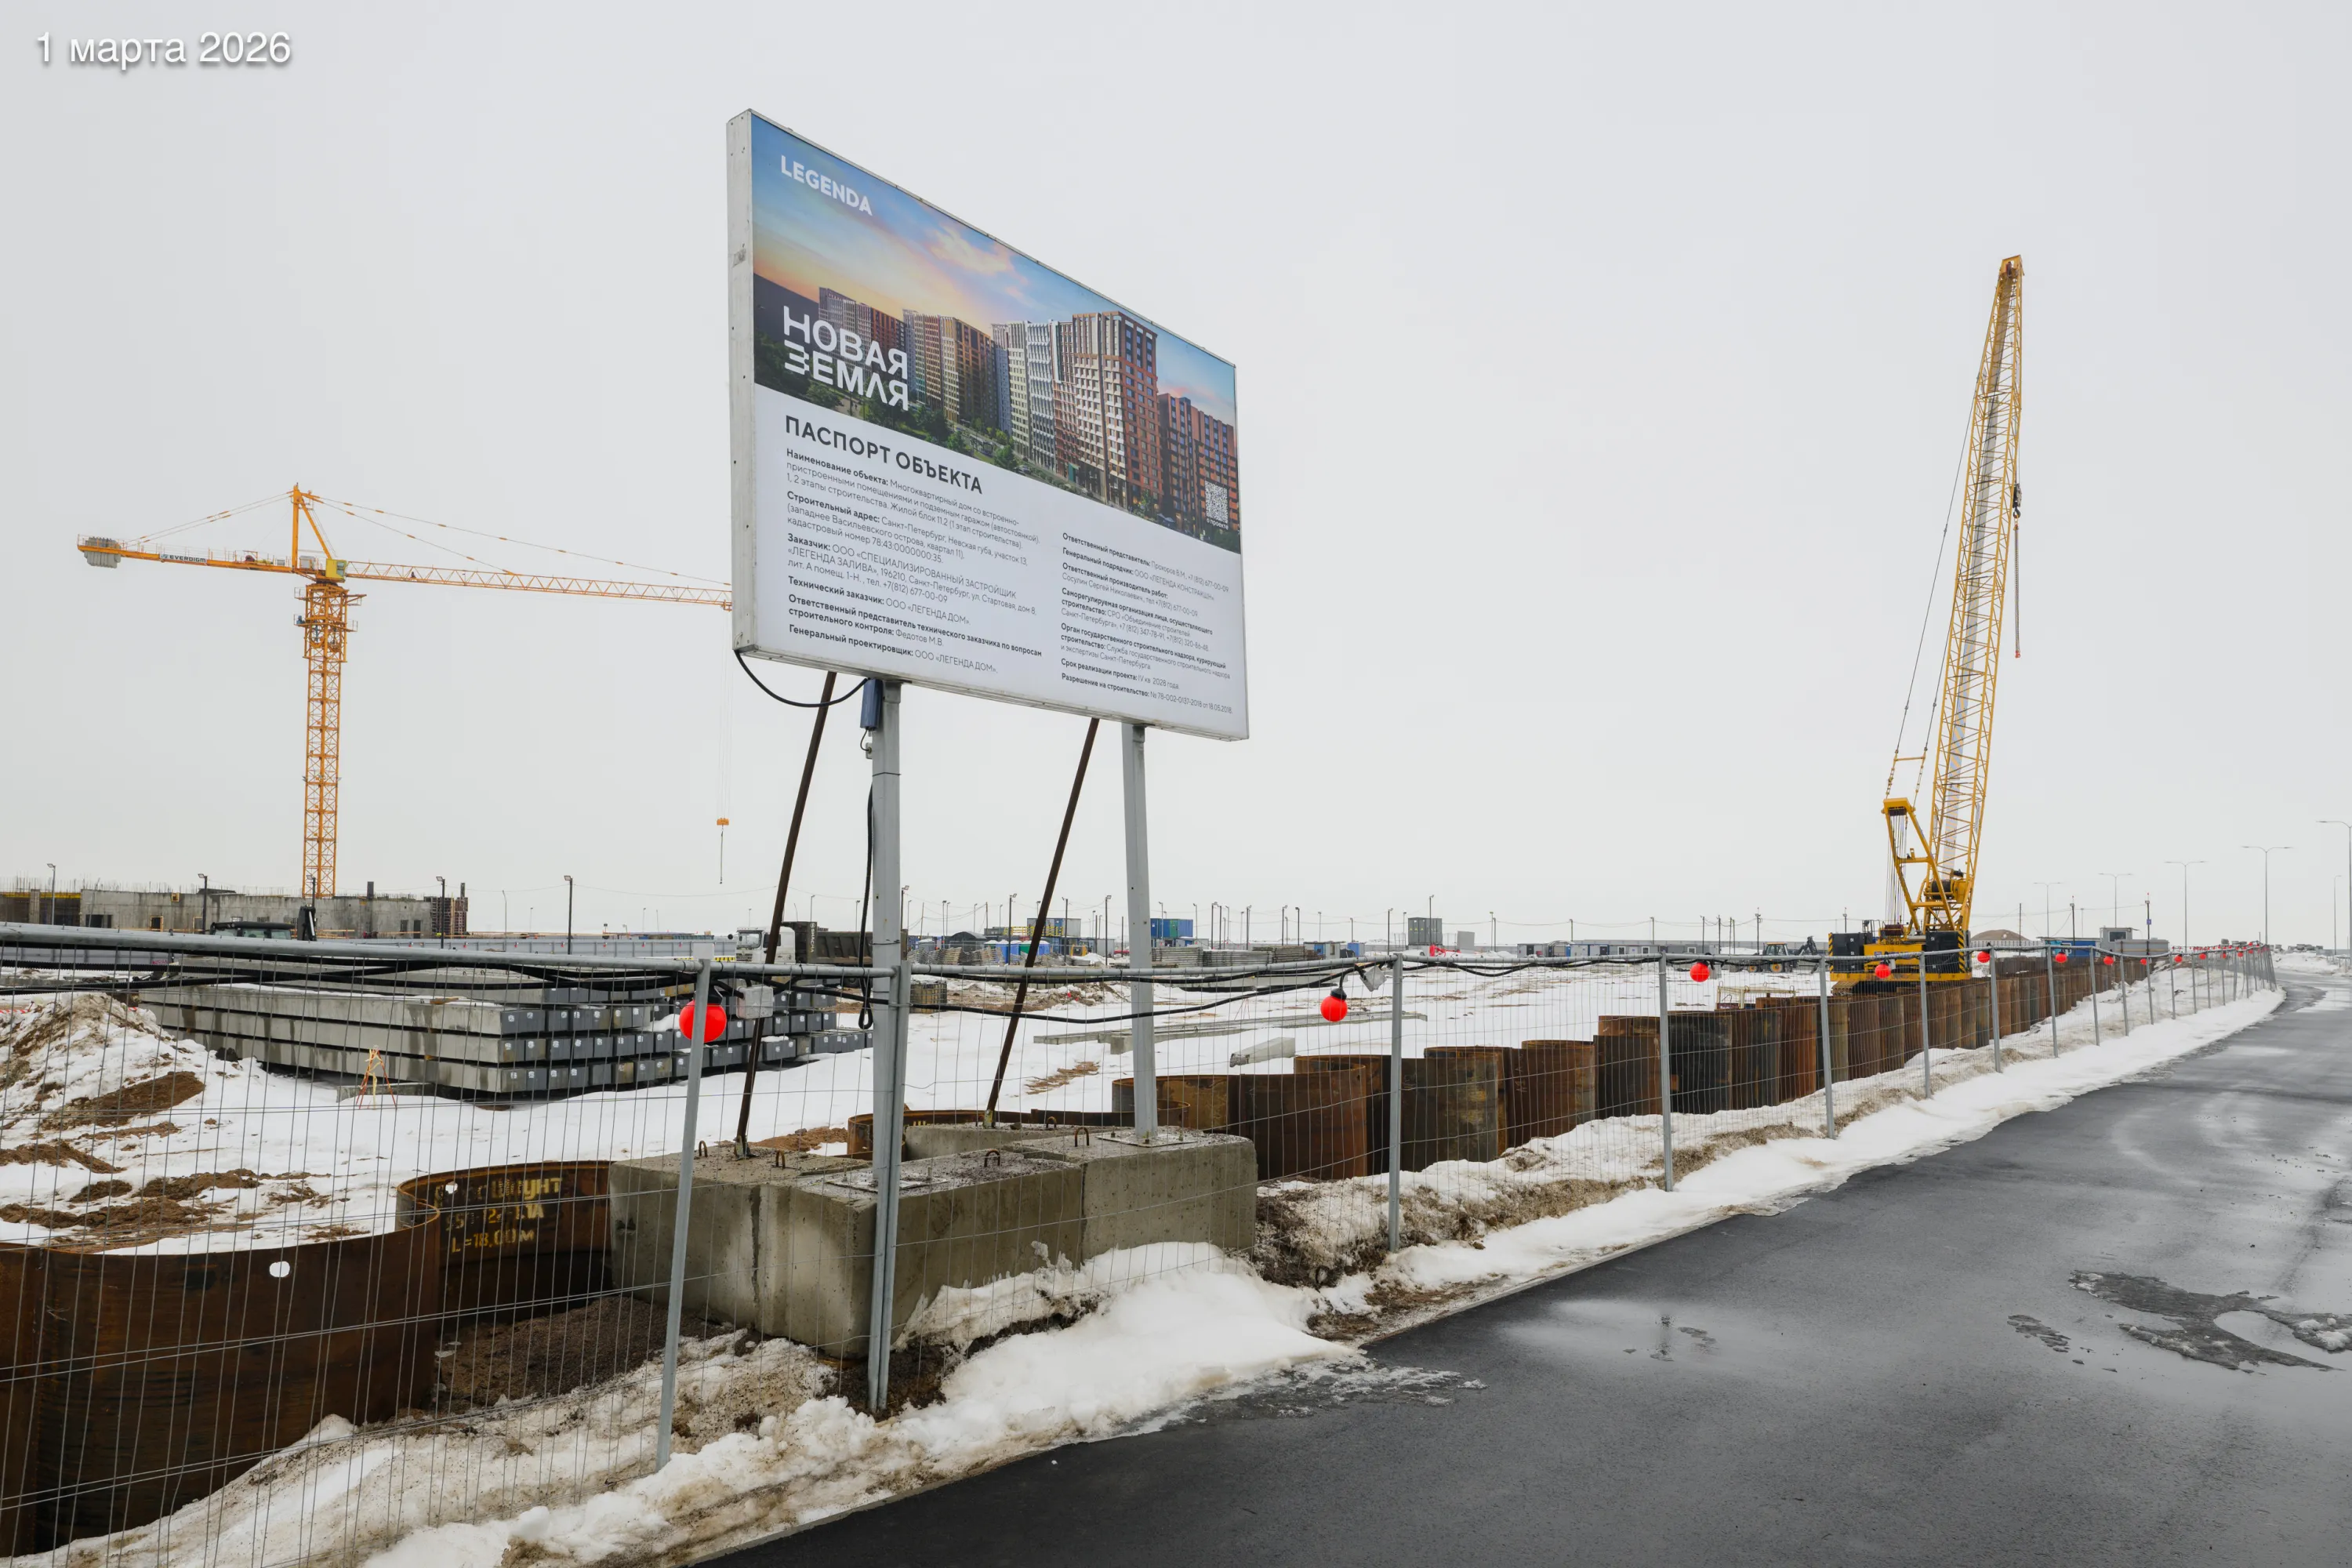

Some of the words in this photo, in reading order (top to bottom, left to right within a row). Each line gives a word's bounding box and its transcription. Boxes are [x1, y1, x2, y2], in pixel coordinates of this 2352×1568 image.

[781, 154, 872, 216] LEGENDA
[783, 306, 909, 380] НОВАЯ
[784, 339, 909, 412] ЗЕМЛЯ
[786, 416, 891, 464] ПАСПОРТ
[895, 451, 982, 494] ОБЪЕКТА
[786, 448, 851, 474] Наименование
[853, 470, 887, 485] объекта:
[890, 479, 957, 506] Многоквартирный
[958, 503, 971, 511] дом
[982, 510, 1019, 525] встроенно-
[786, 462, 855, 488] пристроенными
[856, 482, 912, 504] помещениями
[920, 501, 960, 518] подземным
[960, 514, 989, 528] гаражом
[990, 521, 1040, 544] (автостоянкой).
[786, 490, 851, 515] Строительный
[853, 510, 880, 523] адрес:
[881, 516, 946, 543] Санкт-Петербург,
[948, 535, 976, 550] Невская
[977, 546, 993, 557] губа,
[994, 551, 1019, 563] участок
[787, 503, 830, 521] (западнее
[832, 514, 892, 538] Васильевского
[893, 533, 925, 548] острова,
[927, 543, 954, 555] квартал
[800, 478, 826, 491] этапы
[827, 486, 888, 509] строительства.
[890, 502, 916, 516] Жилой
[918, 510, 935, 522] блок
[937, 516, 948, 526] 11.2
[955, 523, 971, 532] этап
[971, 528, 1022, 550] строительства).
[787, 517, 842, 536] кадастровый
[844, 532, 870, 545] номер
[872, 536, 943, 563] 78:43:0000000:35.
[787, 532, 830, 550] Заказчик:
[832, 543, 855, 557] ООО
[856, 551, 964, 585] «СПЕЦИАЛИЗИРОВАННЫЙ
[965, 579, 1016, 599] ЗАСТРОЙЩИК
[787, 559, 804, 568] лит.
[814, 565, 844, 579] помещ.
[866, 578, 880, 587] тел.
[883, 580, 908, 595] +7(812)
[909, 586, 947, 603] 677-00-09
[788, 546, 836, 564] «ЛЕГЕНДА
[837, 557, 878, 575] ЗАЛИВА»,
[880, 568, 906, 583] 196210,
[909, 575, 970, 599] Санкт-Петербург,
[982, 593, 1016, 611] Стартовая,
[788, 575, 844, 596] Технический
[846, 590, 884, 604] заказчик:
[885, 597, 906, 610] ООО
[907, 604, 946, 619] «ЛЕГЕНДА
[947, 612, 969, 624] ДОМ».
[788, 593, 856, 615] Ответственный
[858, 611, 916, 629] представитель
[916, 623, 965, 640] технического
[967, 635, 1000, 648] заказчика
[1011, 644, 1041, 656] вопросам
[789, 608, 853, 626] строительного
[855, 622, 894, 635] контроля:
[895, 629, 927, 643] Федотов
[928, 636, 943, 646] М.В.
[789, 623, 846, 643] Генеральный
[848, 637, 913, 656] проектировщик:
[914, 649, 934, 660] ООО
[935, 654, 974, 668] «ЛЕГЕНДА
[975, 661, 997, 673] ДОМ».
